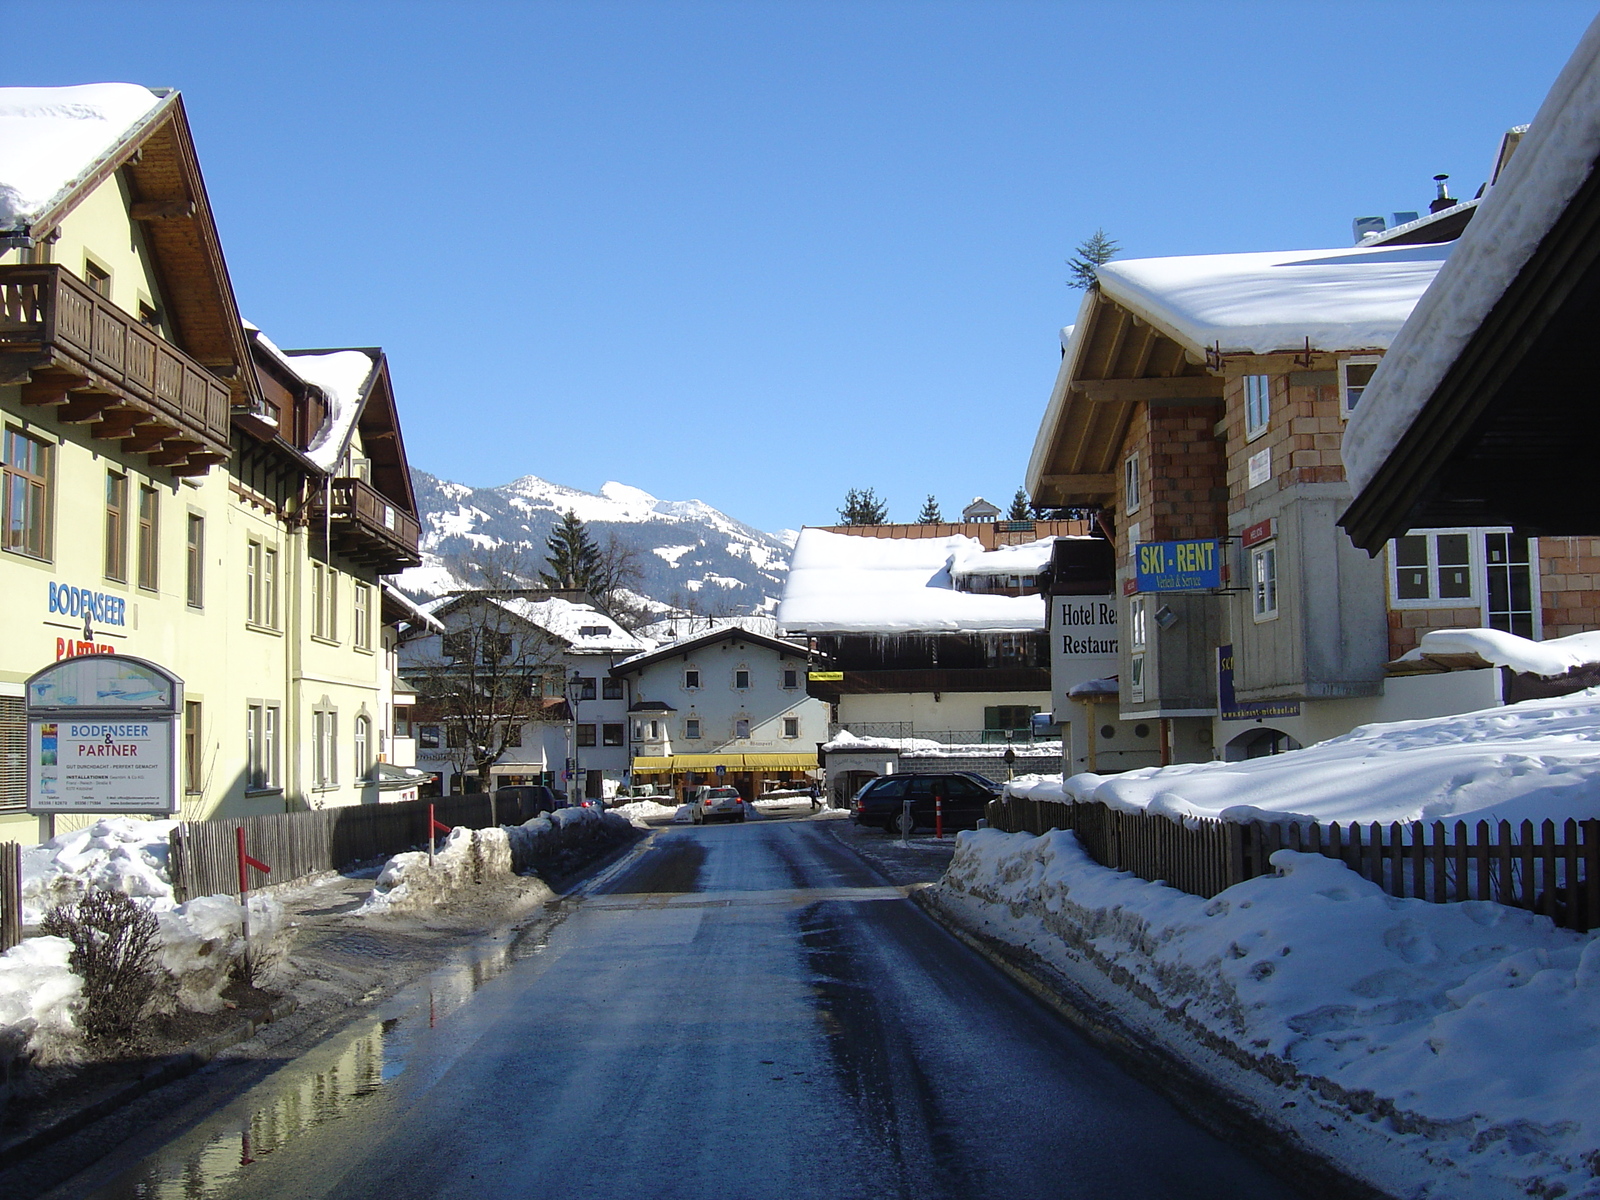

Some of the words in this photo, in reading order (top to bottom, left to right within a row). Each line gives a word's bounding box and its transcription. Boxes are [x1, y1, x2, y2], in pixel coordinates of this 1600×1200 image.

[1141, 545, 1164, 575] SKI
[1176, 542, 1214, 573] RENT
[1181, 573, 1201, 587] Service
[49, 581, 126, 627] BODENSEER
[1062, 602, 1095, 626] Hotel
[83, 611, 94, 641] &
[56, 637, 115, 661] PART
[1222, 706, 1297, 718] www.skirent-michael.at
[71, 725, 149, 737] BODENSEER
[104, 733, 114, 744] &
[78, 744, 138, 757] PARTNER
